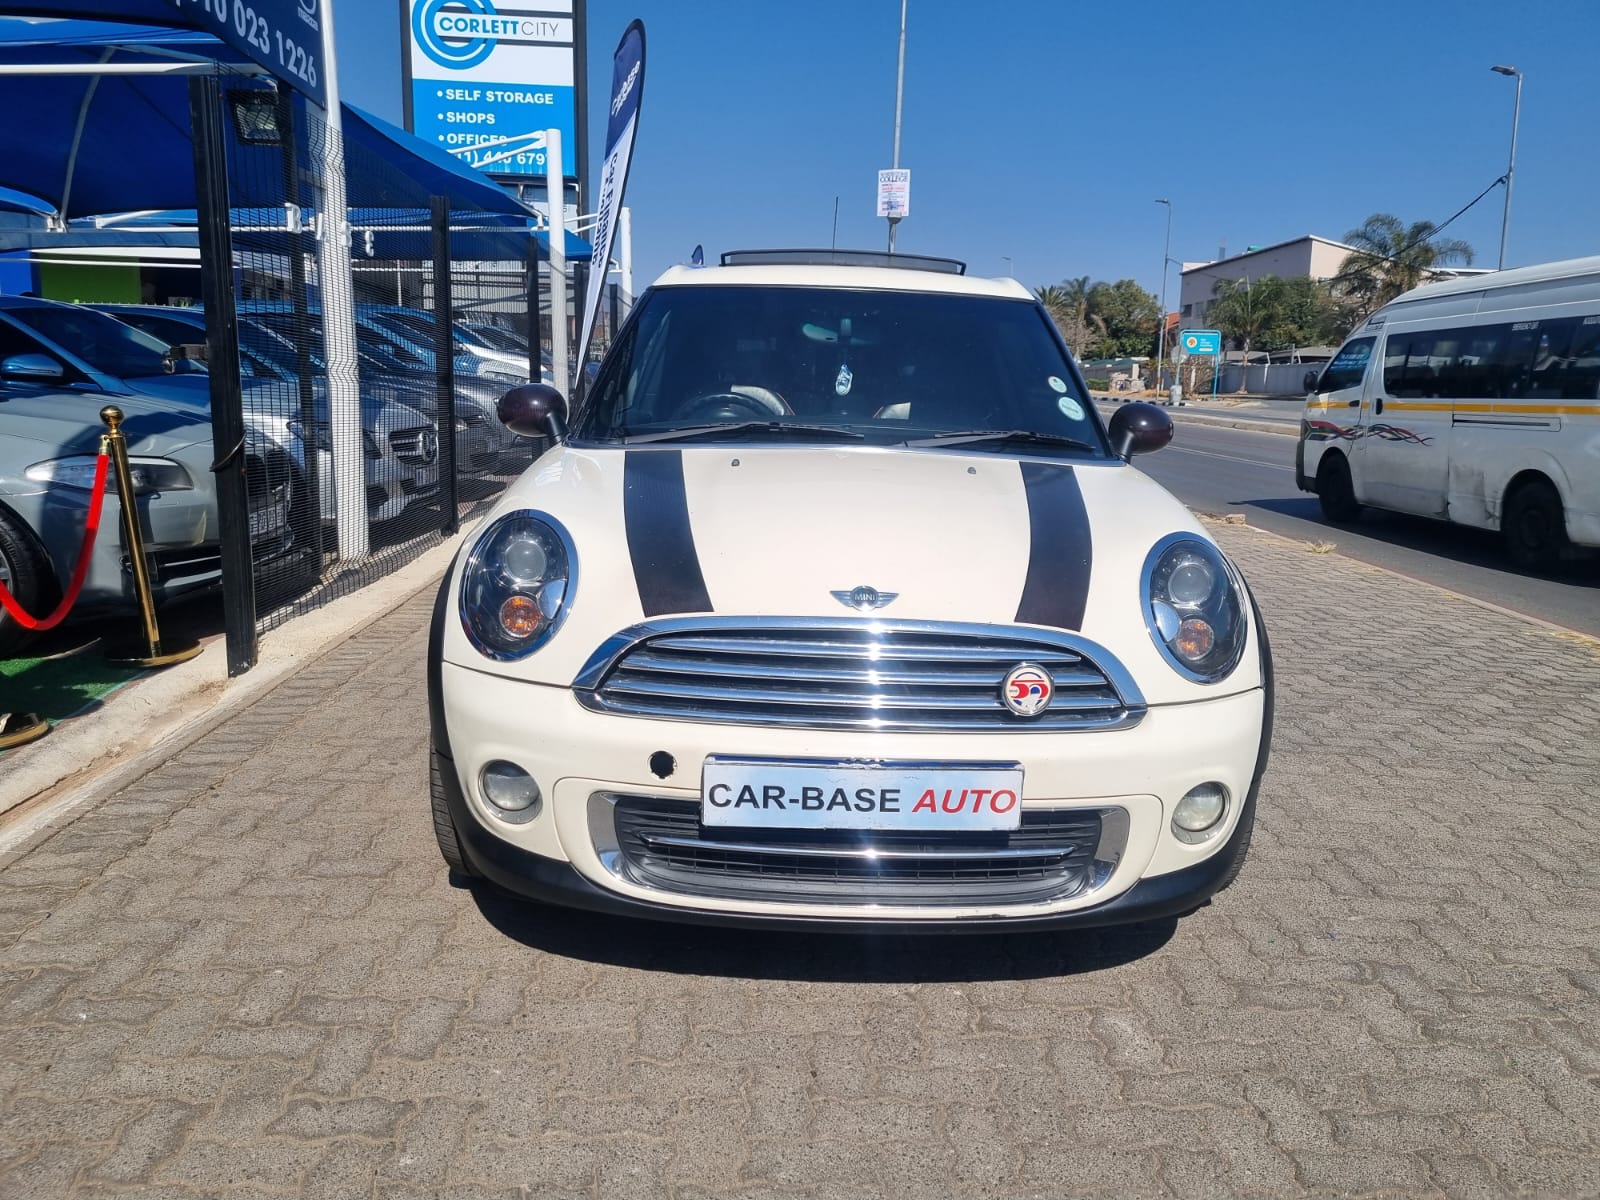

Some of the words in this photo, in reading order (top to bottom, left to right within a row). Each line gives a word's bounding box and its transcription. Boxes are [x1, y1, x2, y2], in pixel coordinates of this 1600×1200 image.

[439, 16, 519, 35] CORLETT
[521, 21, 559, 37] CITY
[234, 0, 271, 55] 023
[275, 30, 317, 88] 1226
[445, 89, 481, 101] SELF
[485, 91, 554, 105] STORAGE
[446, 111, 496, 125] SHOPS
[516, 152, 548, 166] 679
[854, 593, 878, 601] MINI
[708, 782, 901, 813] CAR-BASE
[911, 788, 1017, 814] AUTO
